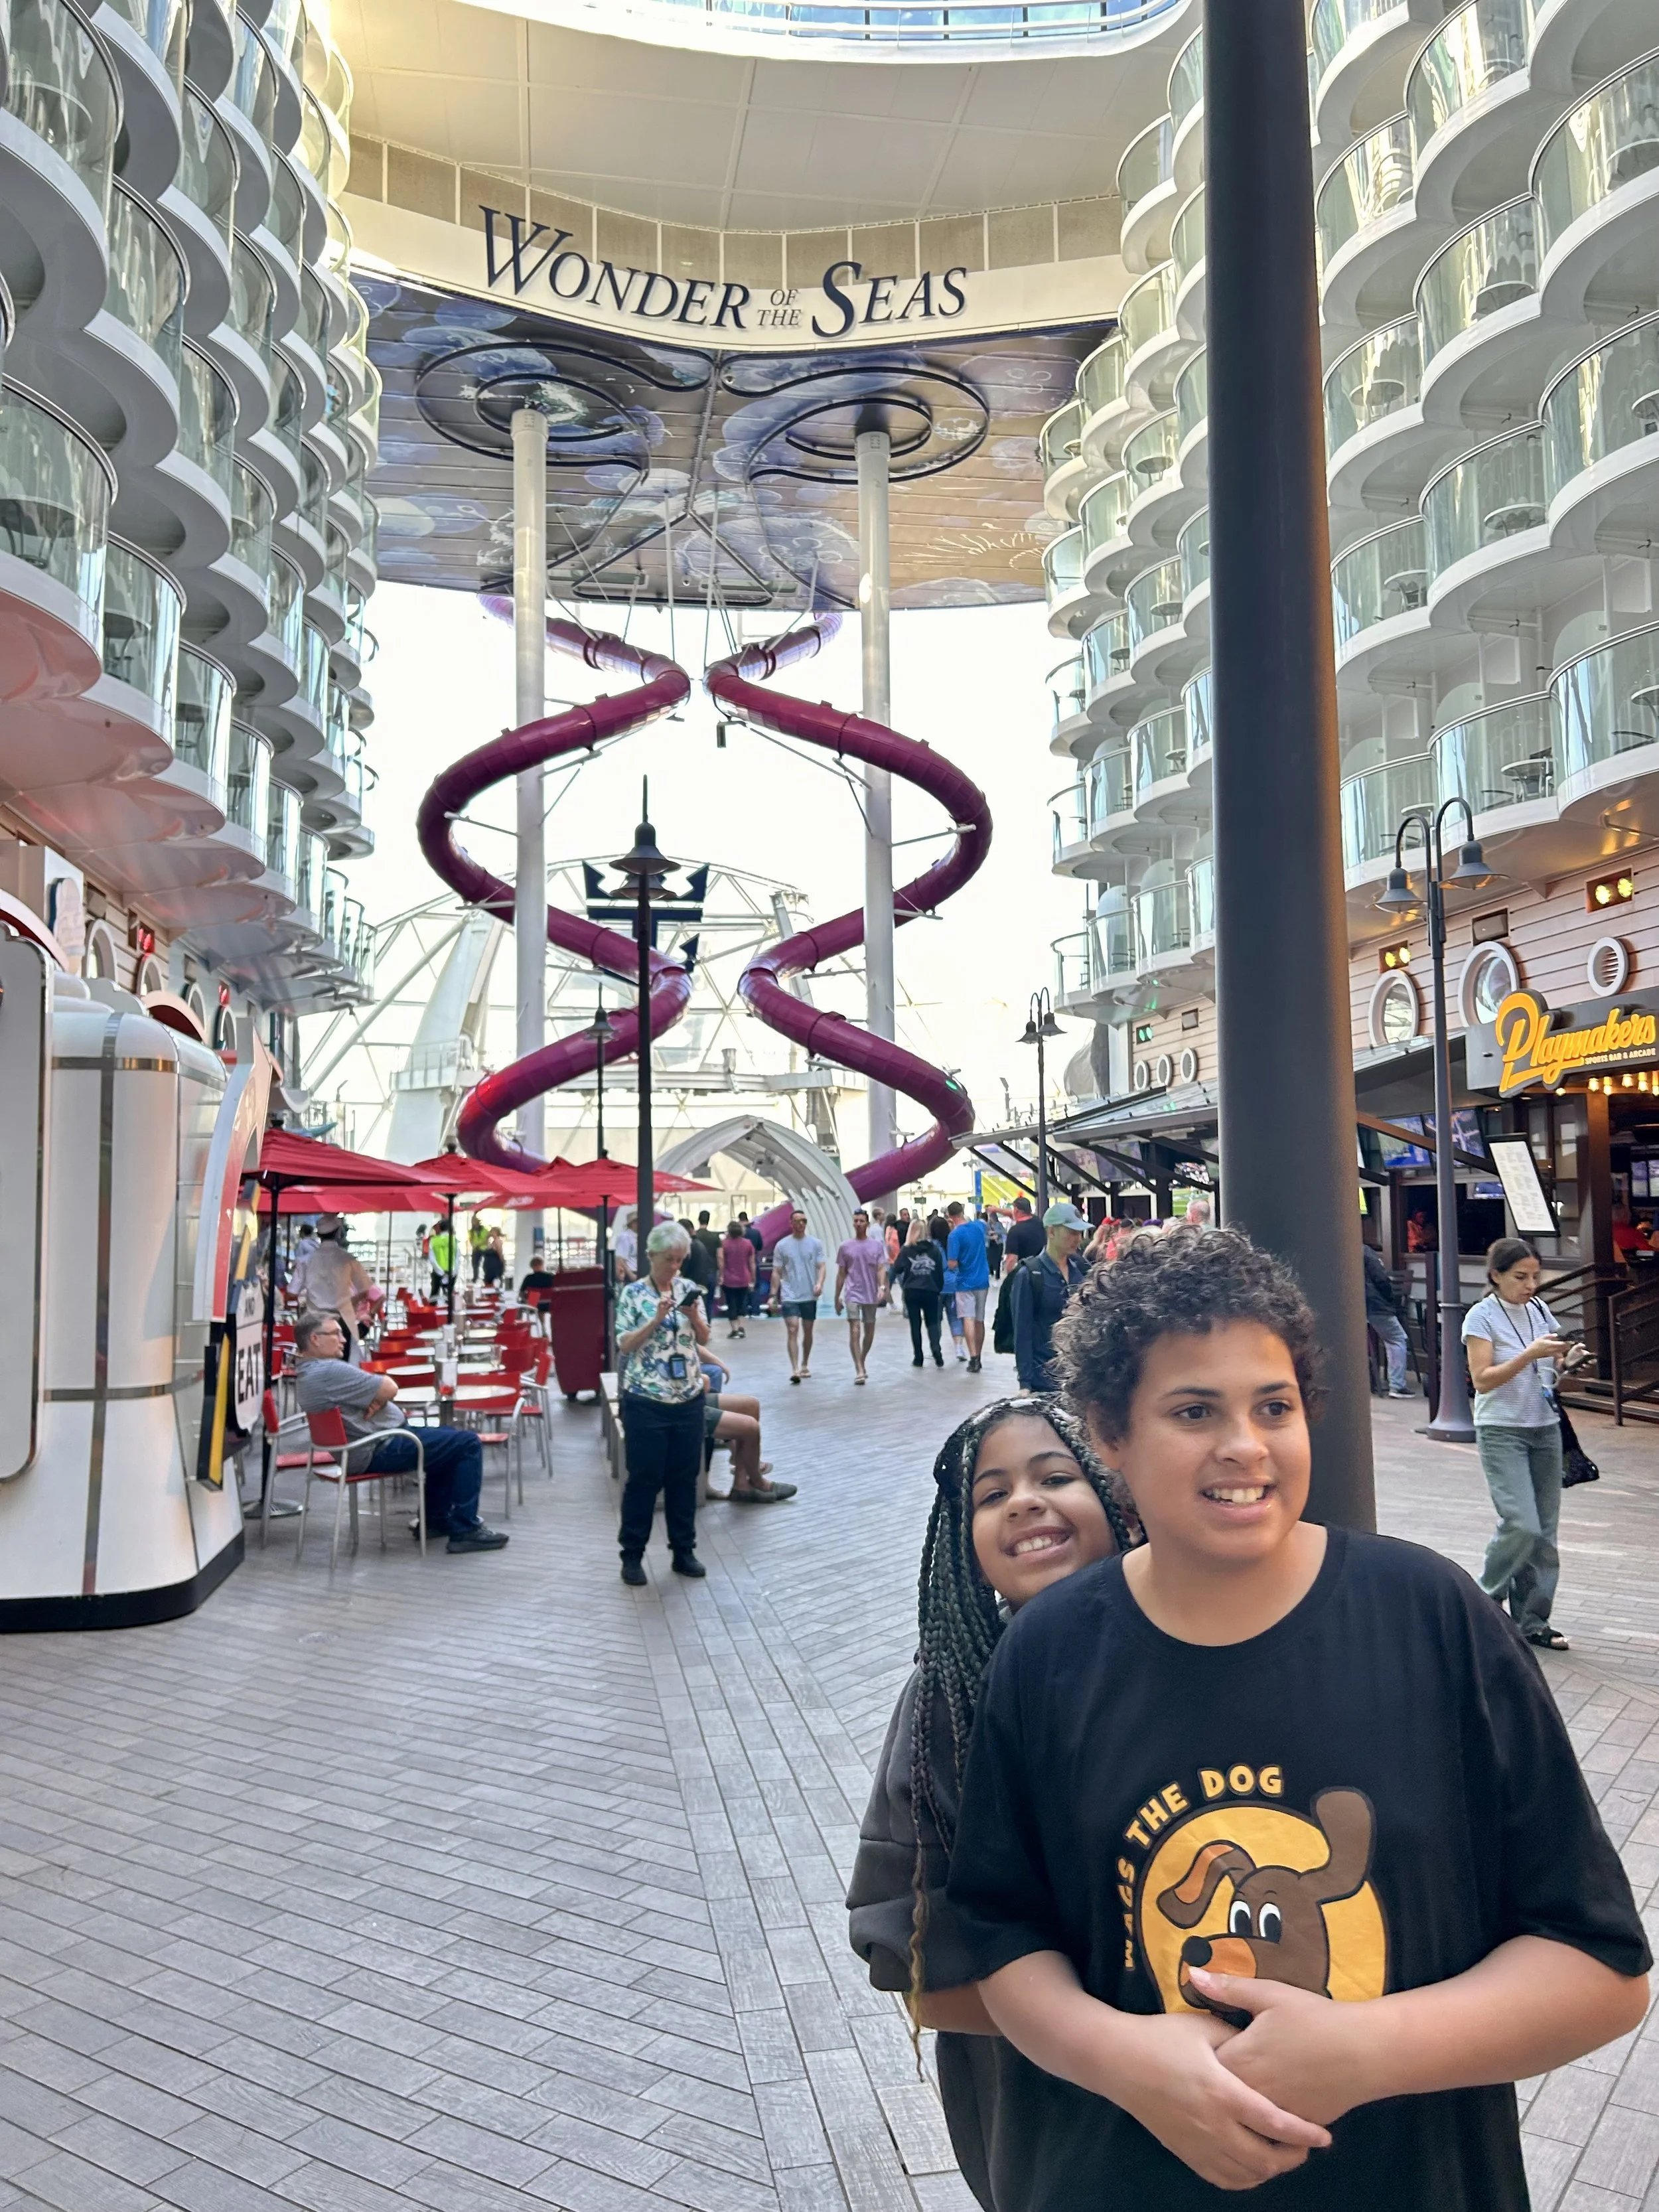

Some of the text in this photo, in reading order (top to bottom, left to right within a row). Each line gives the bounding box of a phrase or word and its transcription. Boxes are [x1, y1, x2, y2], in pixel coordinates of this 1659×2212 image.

[478, 204, 967, 338] WONDER OF THE SEAS
[1495, 992, 1656, 1092] Playmakers
[1585, 1055, 1609, 1065] SPORTS
[1609, 1053, 1623, 1062] BAR
[1628, 1047, 1656, 1059] ARCADE
[237, 1341, 261, 1405] EAT
[1125, 1782, 1189, 1848] THE
[1199, 1764, 1283, 1799] DOG
